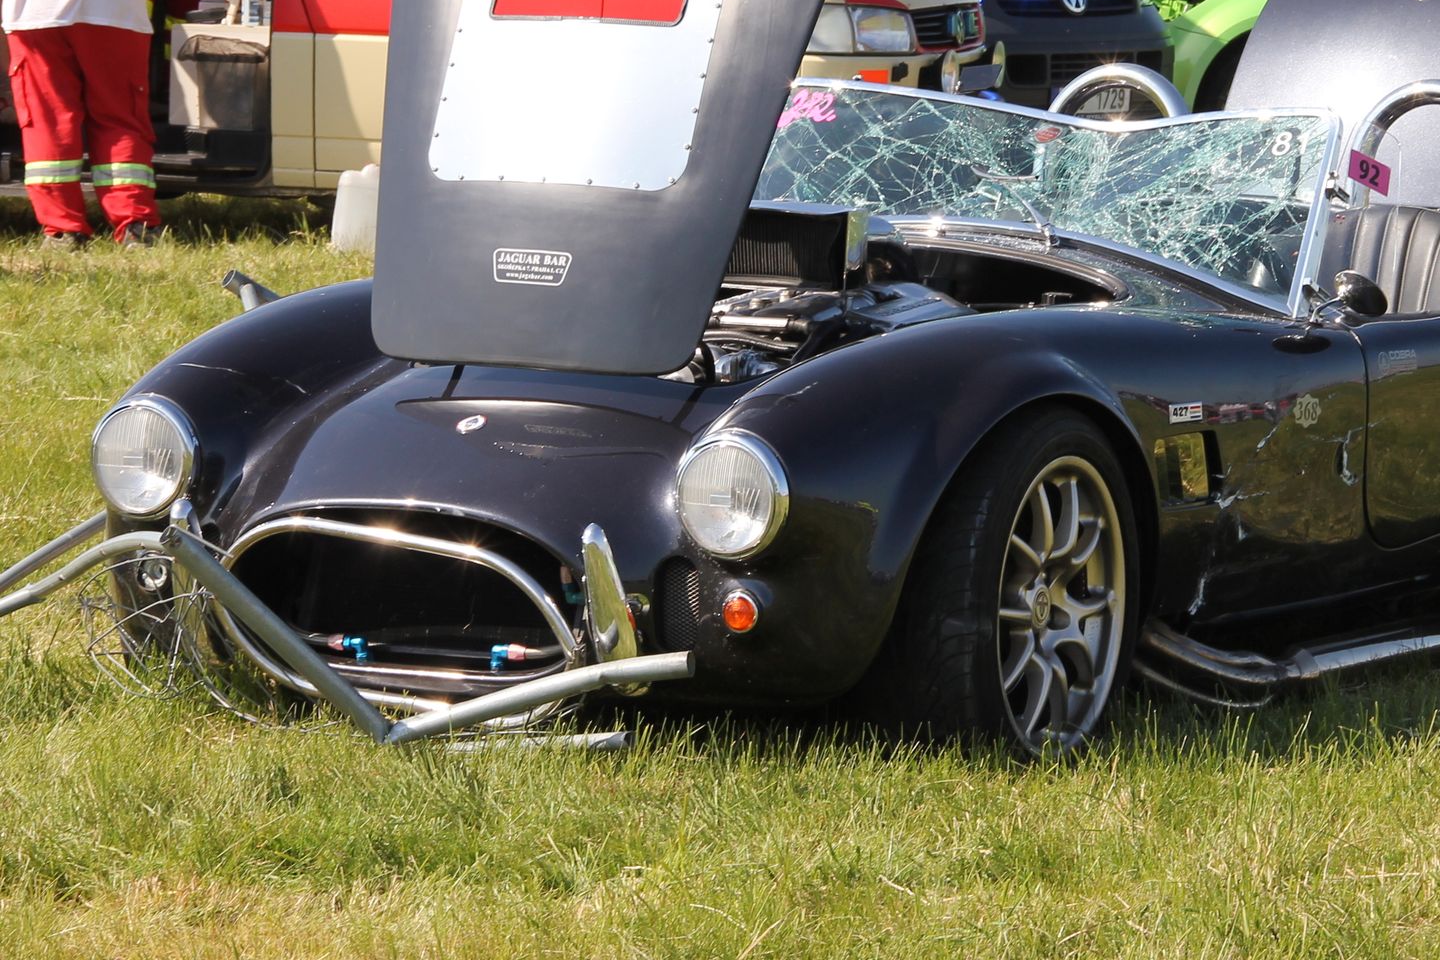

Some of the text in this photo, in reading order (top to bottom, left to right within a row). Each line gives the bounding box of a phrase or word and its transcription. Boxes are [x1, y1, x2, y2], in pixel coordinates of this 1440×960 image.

[1359, 159, 1380, 187] 92
[498, 252, 567, 266] JAGUAR BAR
[1172, 406, 1189, 418] 427
[1296, 398, 1318, 421] 368
